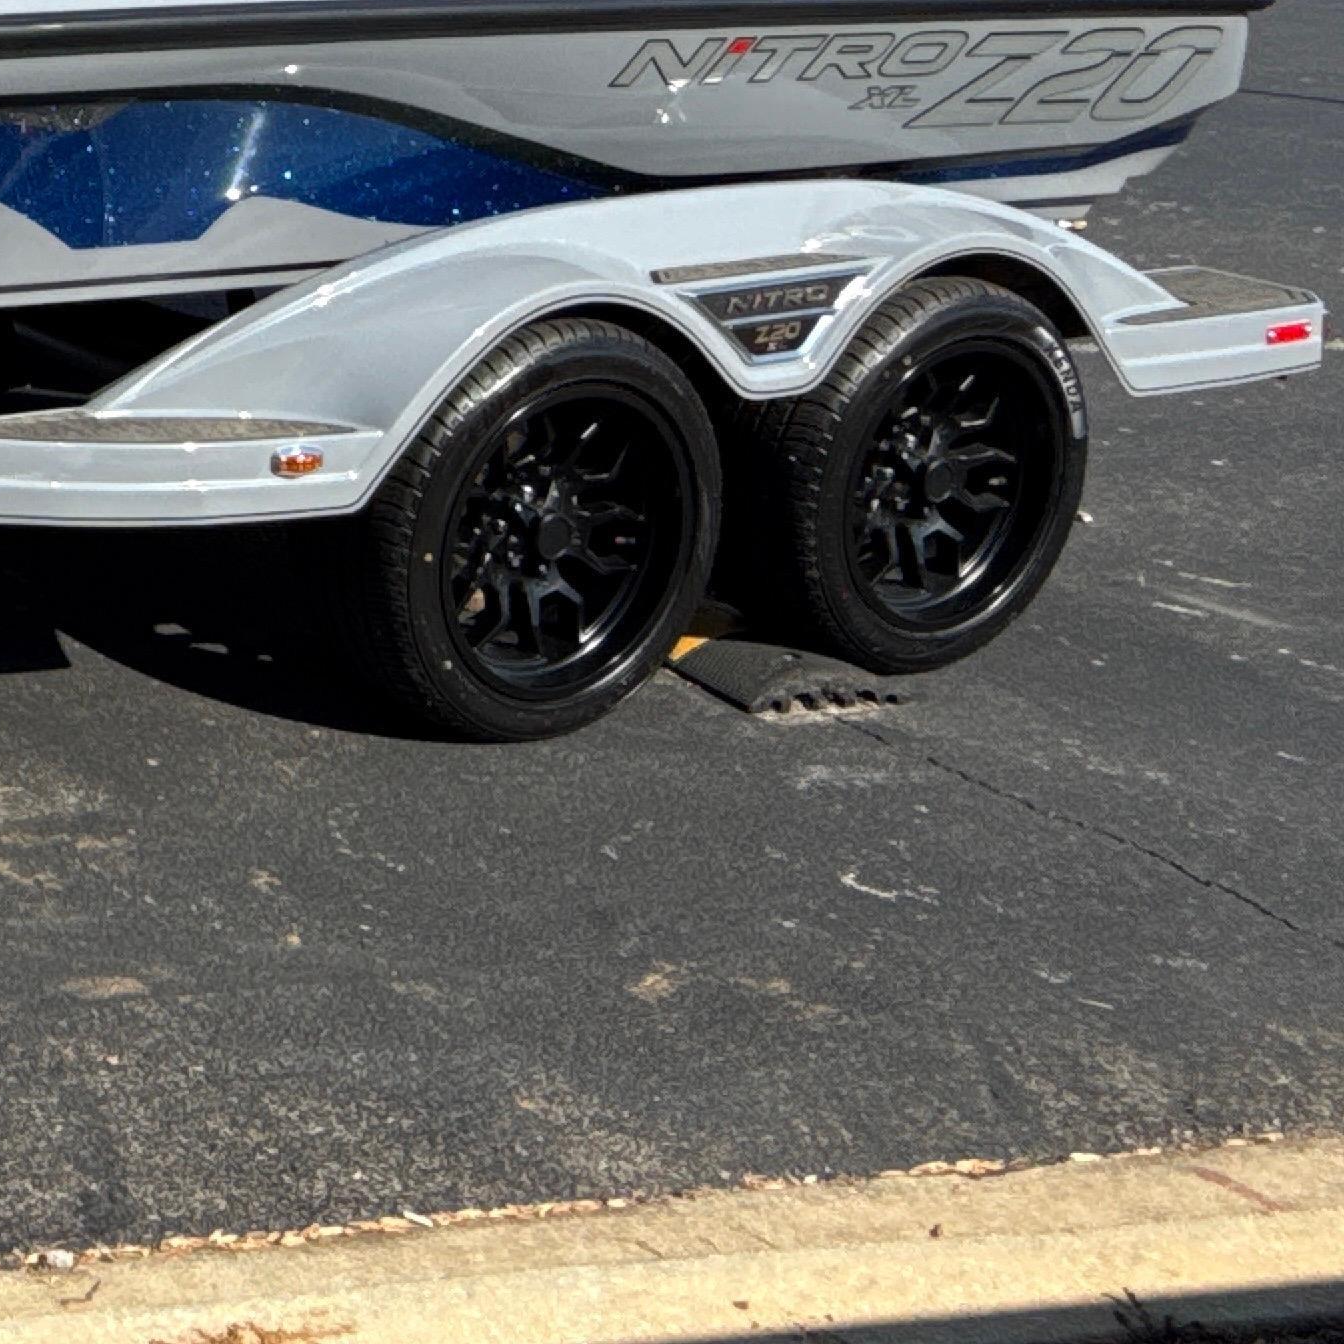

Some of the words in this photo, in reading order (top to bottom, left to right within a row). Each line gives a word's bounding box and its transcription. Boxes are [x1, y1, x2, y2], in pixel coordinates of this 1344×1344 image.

[901, 25, 1225, 130] Z20
[727, 284, 831, 315] NITRO
[754, 321, 803, 345] Z20
